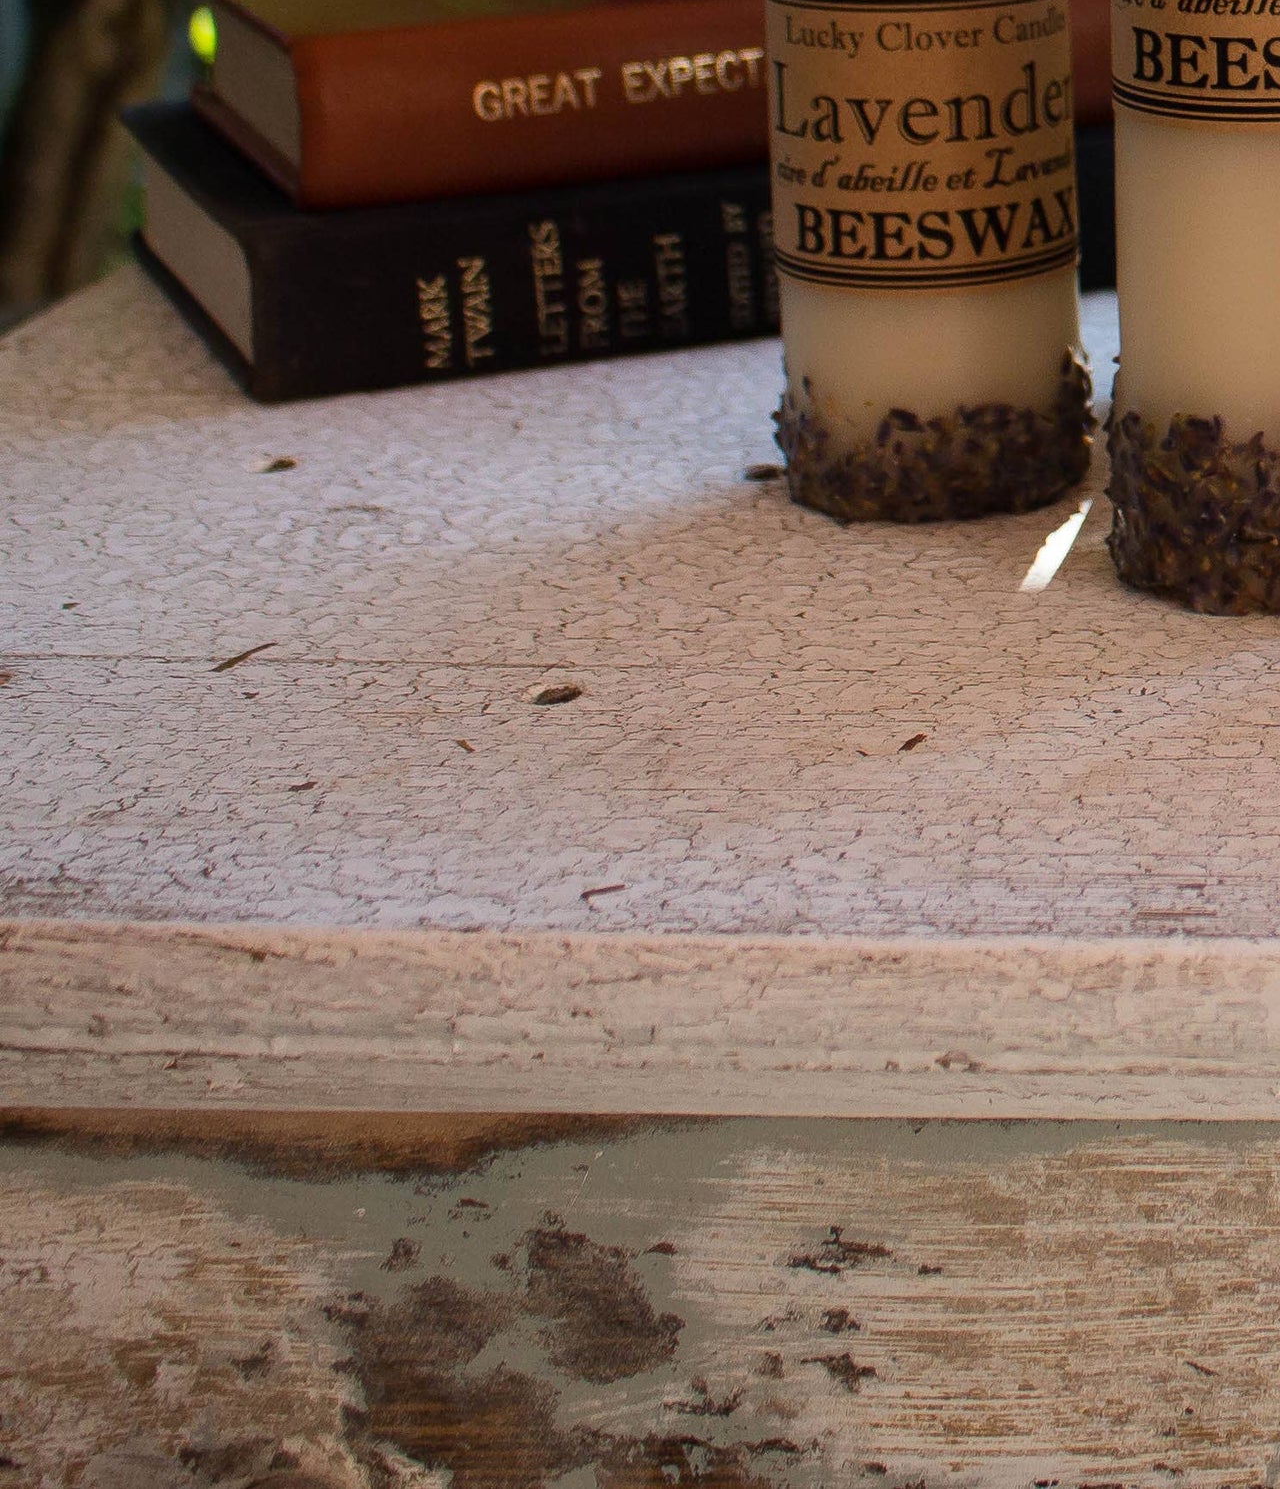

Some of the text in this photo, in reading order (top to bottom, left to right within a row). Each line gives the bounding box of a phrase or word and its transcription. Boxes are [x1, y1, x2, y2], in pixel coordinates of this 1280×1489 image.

[785, 15, 865, 58] Lucky
[875, 21, 984, 53] Clover
[472, 66, 602, 123] GREAT
[945, 166, 977, 191] et
[415, 272, 452, 370] MARK
[455, 255, 495, 368] TWAIN
[526, 217, 569, 358] LETTERS
[575, 257, 609, 350] FROM
